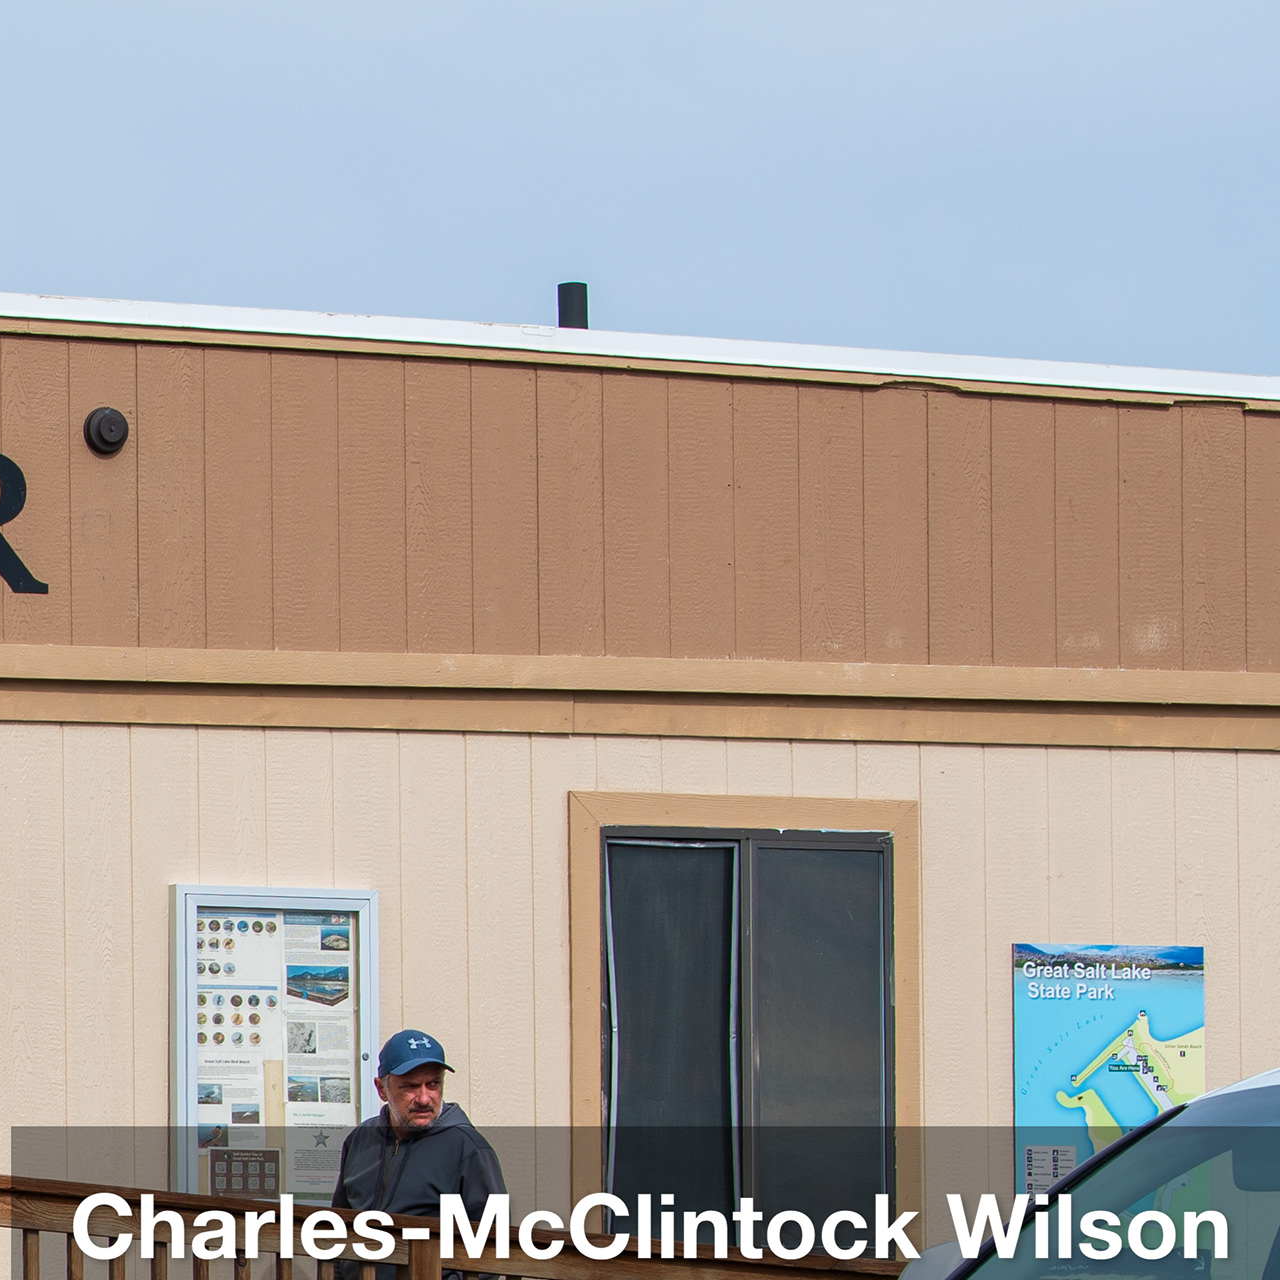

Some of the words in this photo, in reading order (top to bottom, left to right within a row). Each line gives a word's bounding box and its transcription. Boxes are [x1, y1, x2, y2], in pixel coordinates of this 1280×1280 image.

[1023, 962, 1070, 978] Great
[1074, 963, 1107, 979] Salt
[1112, 963, 1152, 980] Lake
[1028, 982, 1071, 999] State
[1077, 984, 1114, 999] Park
